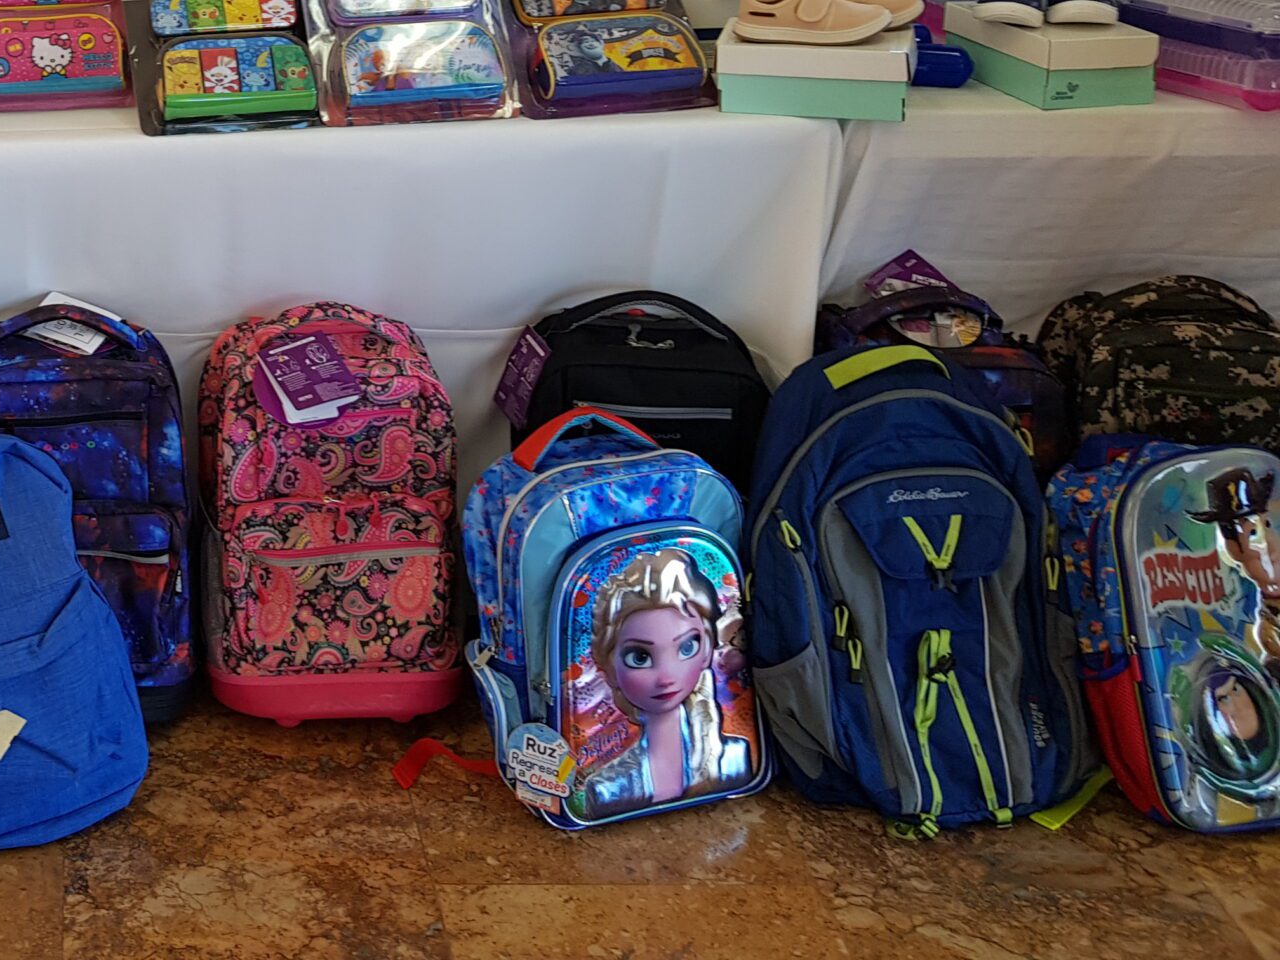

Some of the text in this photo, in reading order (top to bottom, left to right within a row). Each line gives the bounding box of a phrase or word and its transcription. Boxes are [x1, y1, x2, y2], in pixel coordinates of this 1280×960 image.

[1143, 549, 1226, 609] RESCUE
[518, 769, 567, 795] a Clases
